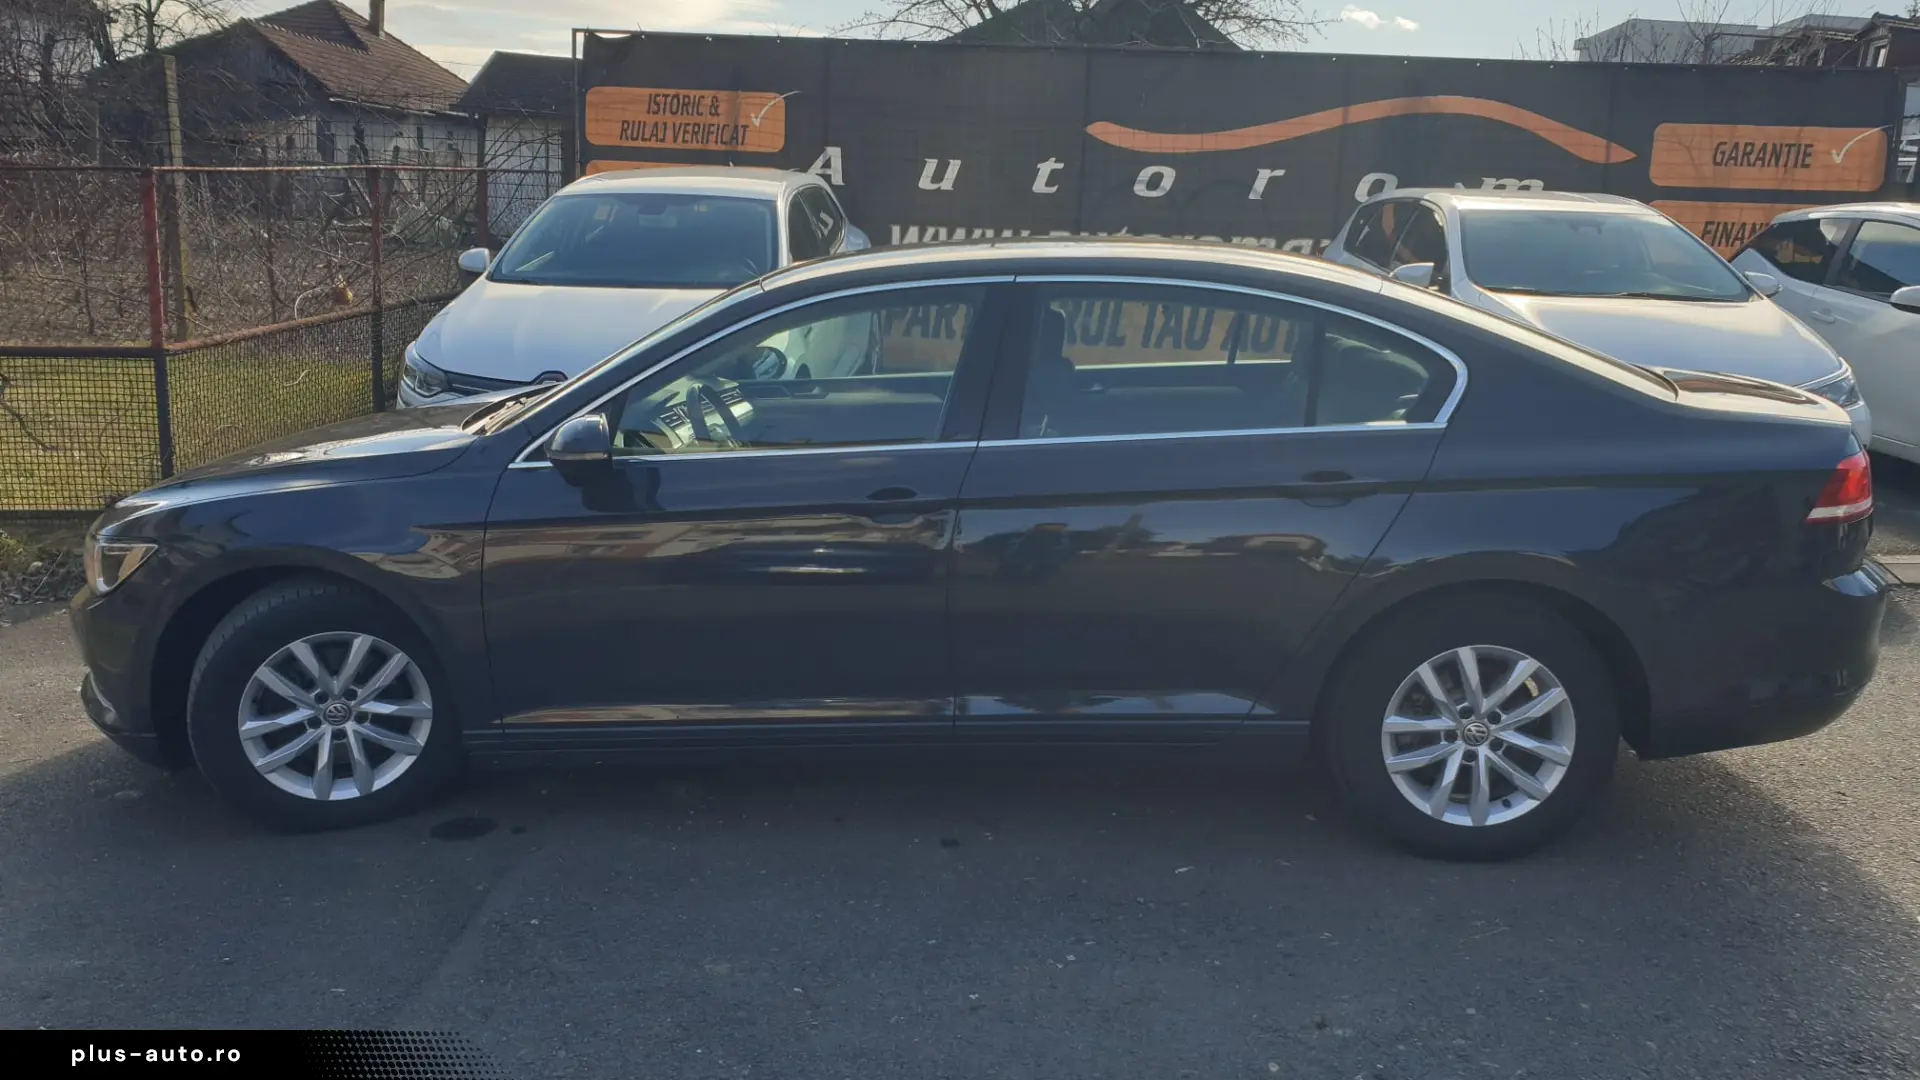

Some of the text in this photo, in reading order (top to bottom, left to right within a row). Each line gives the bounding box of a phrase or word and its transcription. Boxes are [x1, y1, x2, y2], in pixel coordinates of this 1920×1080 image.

[646, 93, 720, 117] ISTORIC &
[620, 120, 750, 146] RULAJ VERIFICAT
[1712, 141, 1815, 169] GARANTIE
